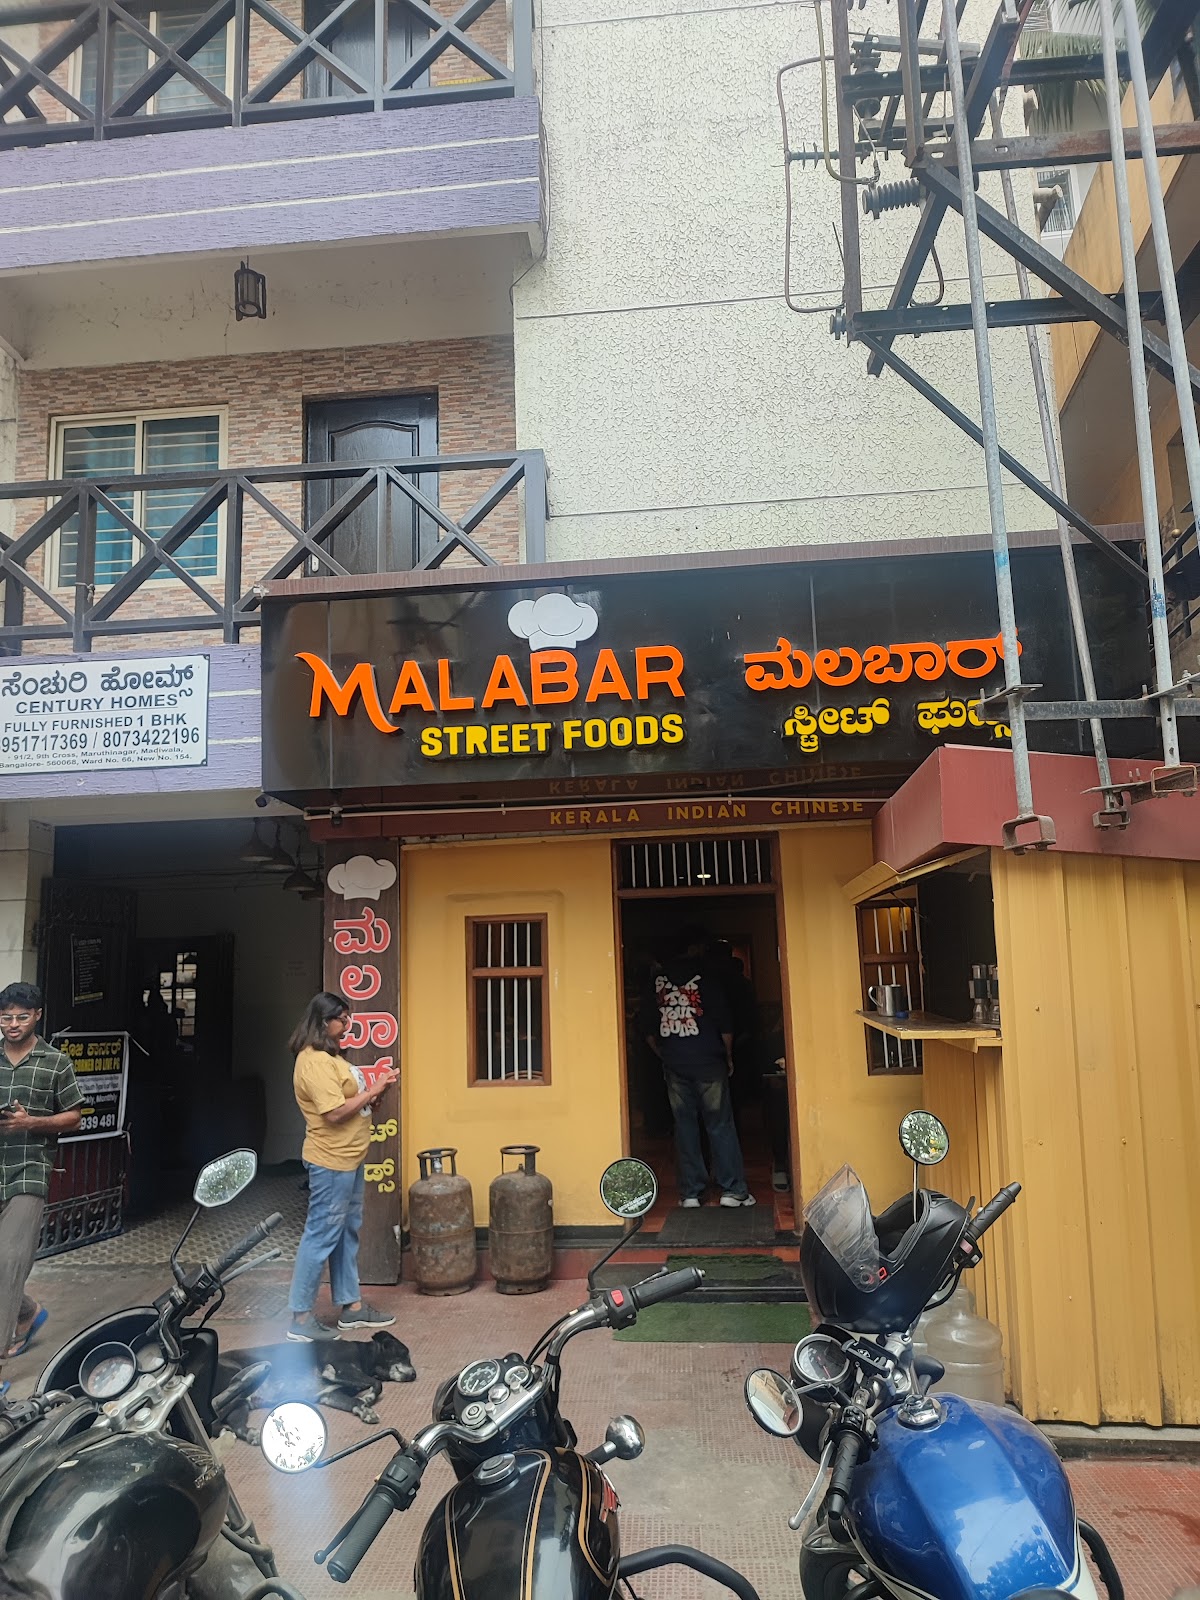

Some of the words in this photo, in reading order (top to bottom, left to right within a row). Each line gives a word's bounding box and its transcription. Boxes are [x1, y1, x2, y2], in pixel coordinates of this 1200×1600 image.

[1, 670, 88, 697] ಸೆಂಚುರಿ
[101, 663, 193, 698] ಹೋಮ್ಸ್
[293, 645, 686, 734] MALABAR
[16, 697, 104, 714] CENTURY
[111, 693, 178, 709] HOMES
[4, 721, 48, 733] FULLY
[52, 716, 133, 731] FURNISHED
[137, 715, 144, 727] 1
[151, 713, 187, 727] BHK
[784, 697, 890, 753] ಸ್ಟ್ರೀಟ್
[103, 727, 200, 748] 8073422196
[421, 721, 552, 757] STREET
[563, 713, 685, 750] FOODS
[52, 752, 78, 760] Cross,
[80, 749, 139, 758] Maruthinagar,
[141, 747, 184, 755] Madiwala,
[550, 808, 640, 825] KERALA
[668, 803, 746, 821] INDIAN
[770, 800, 864, 815] CHINESE
[99, 1113, 115, 1128] 481
